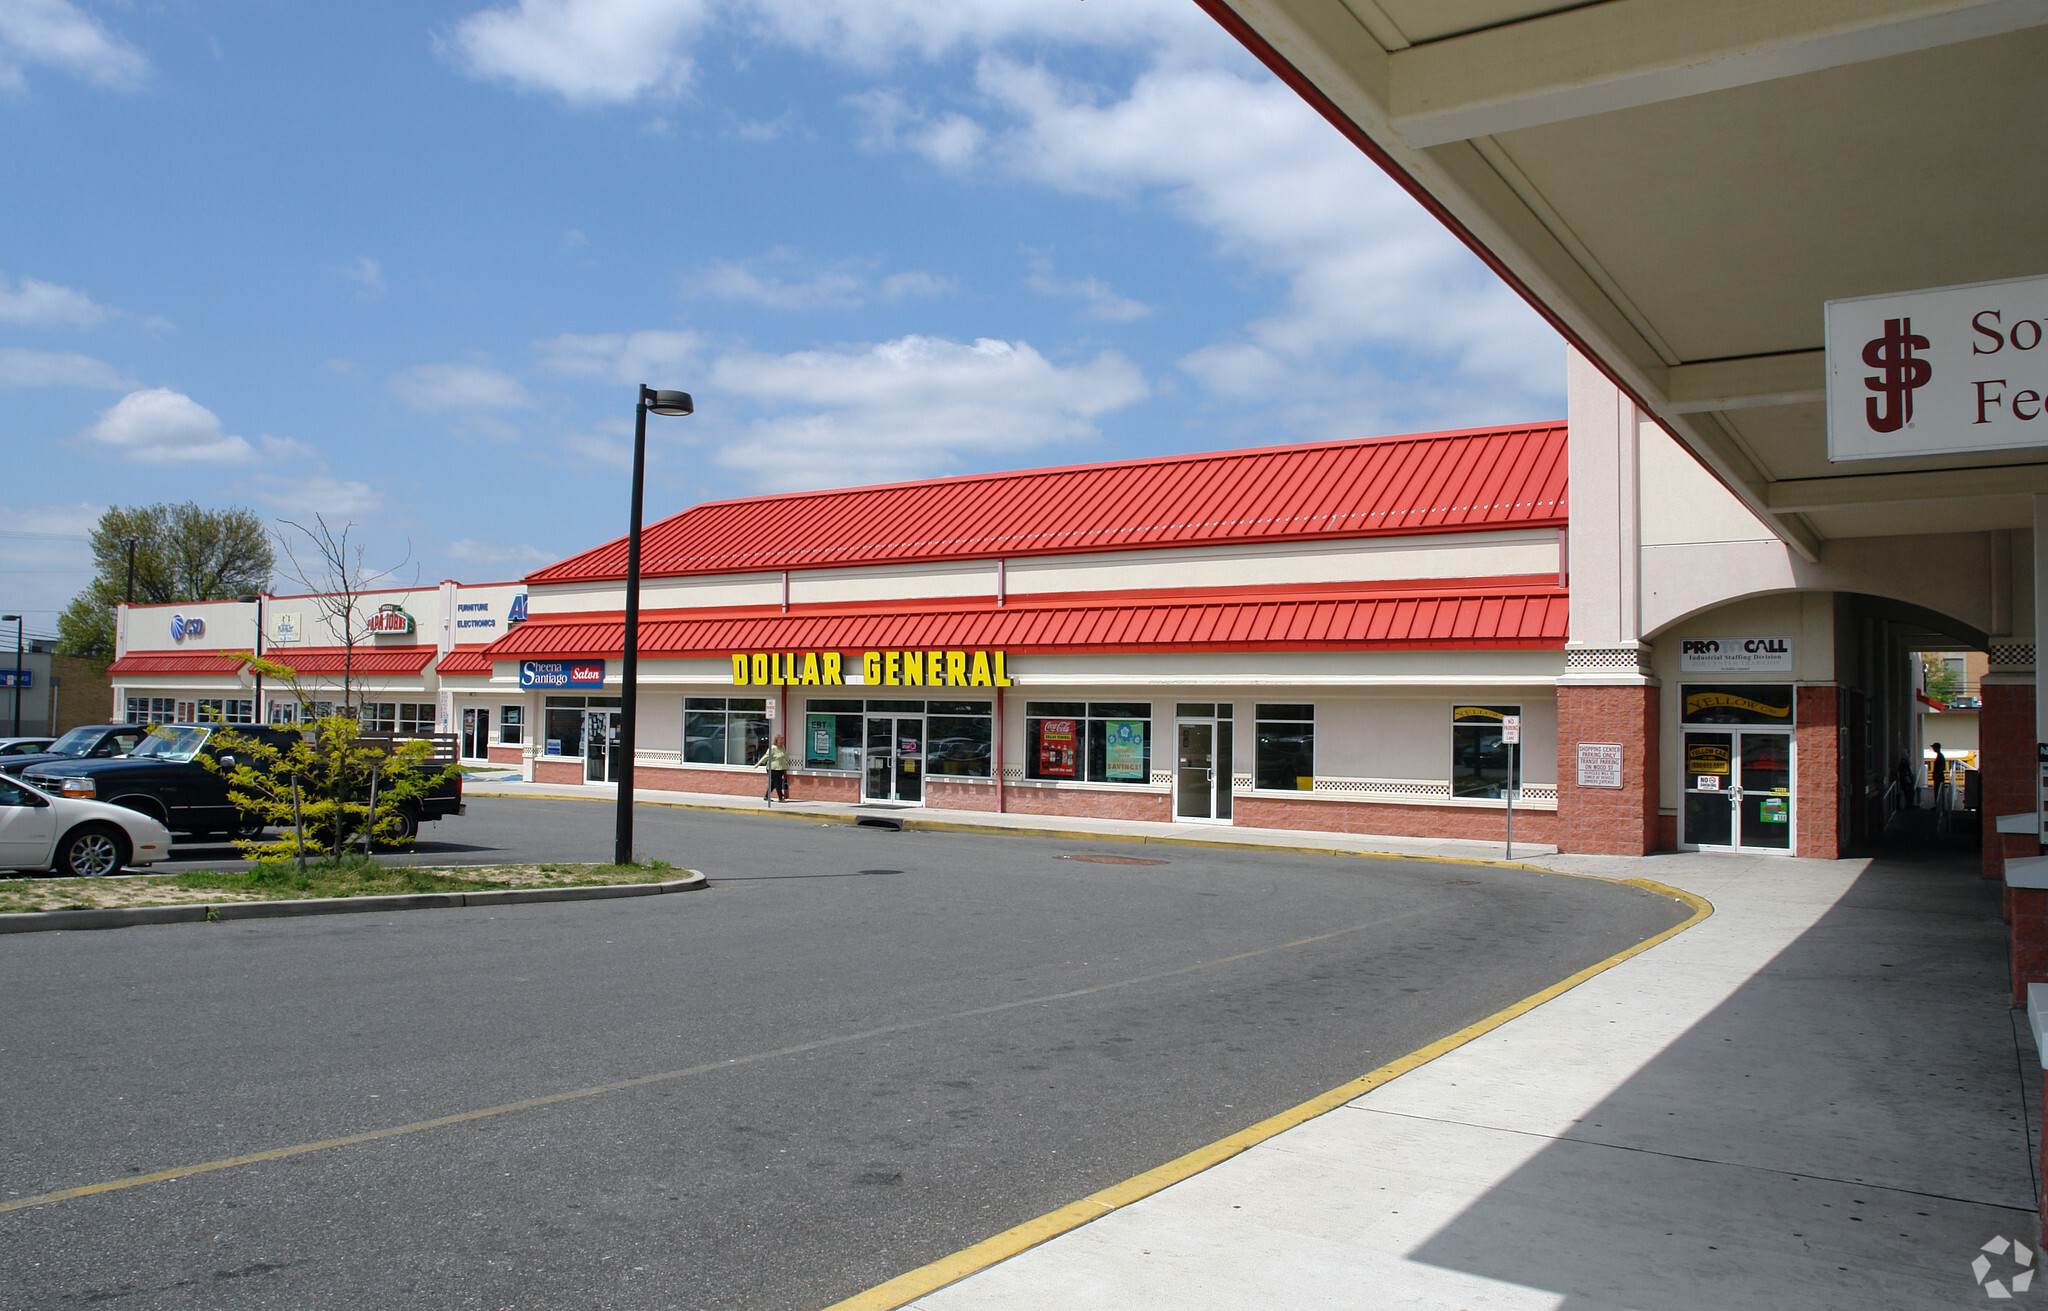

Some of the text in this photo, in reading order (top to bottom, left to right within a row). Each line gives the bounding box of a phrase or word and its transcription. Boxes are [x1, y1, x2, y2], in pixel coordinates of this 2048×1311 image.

[1971, 309, 2048, 356] So
[1970, 379, 2048, 425] Fe
[457, 603, 488, 612] FURNITURE
[457, 619, 496, 628] ELECTRONICS
[522, 661, 562, 681] Sheena
[572, 667, 600, 680] Salon
[732, 651, 1012, 687] DOLLAR GENERAL
[1688, 697, 1760, 709] YELLOW
